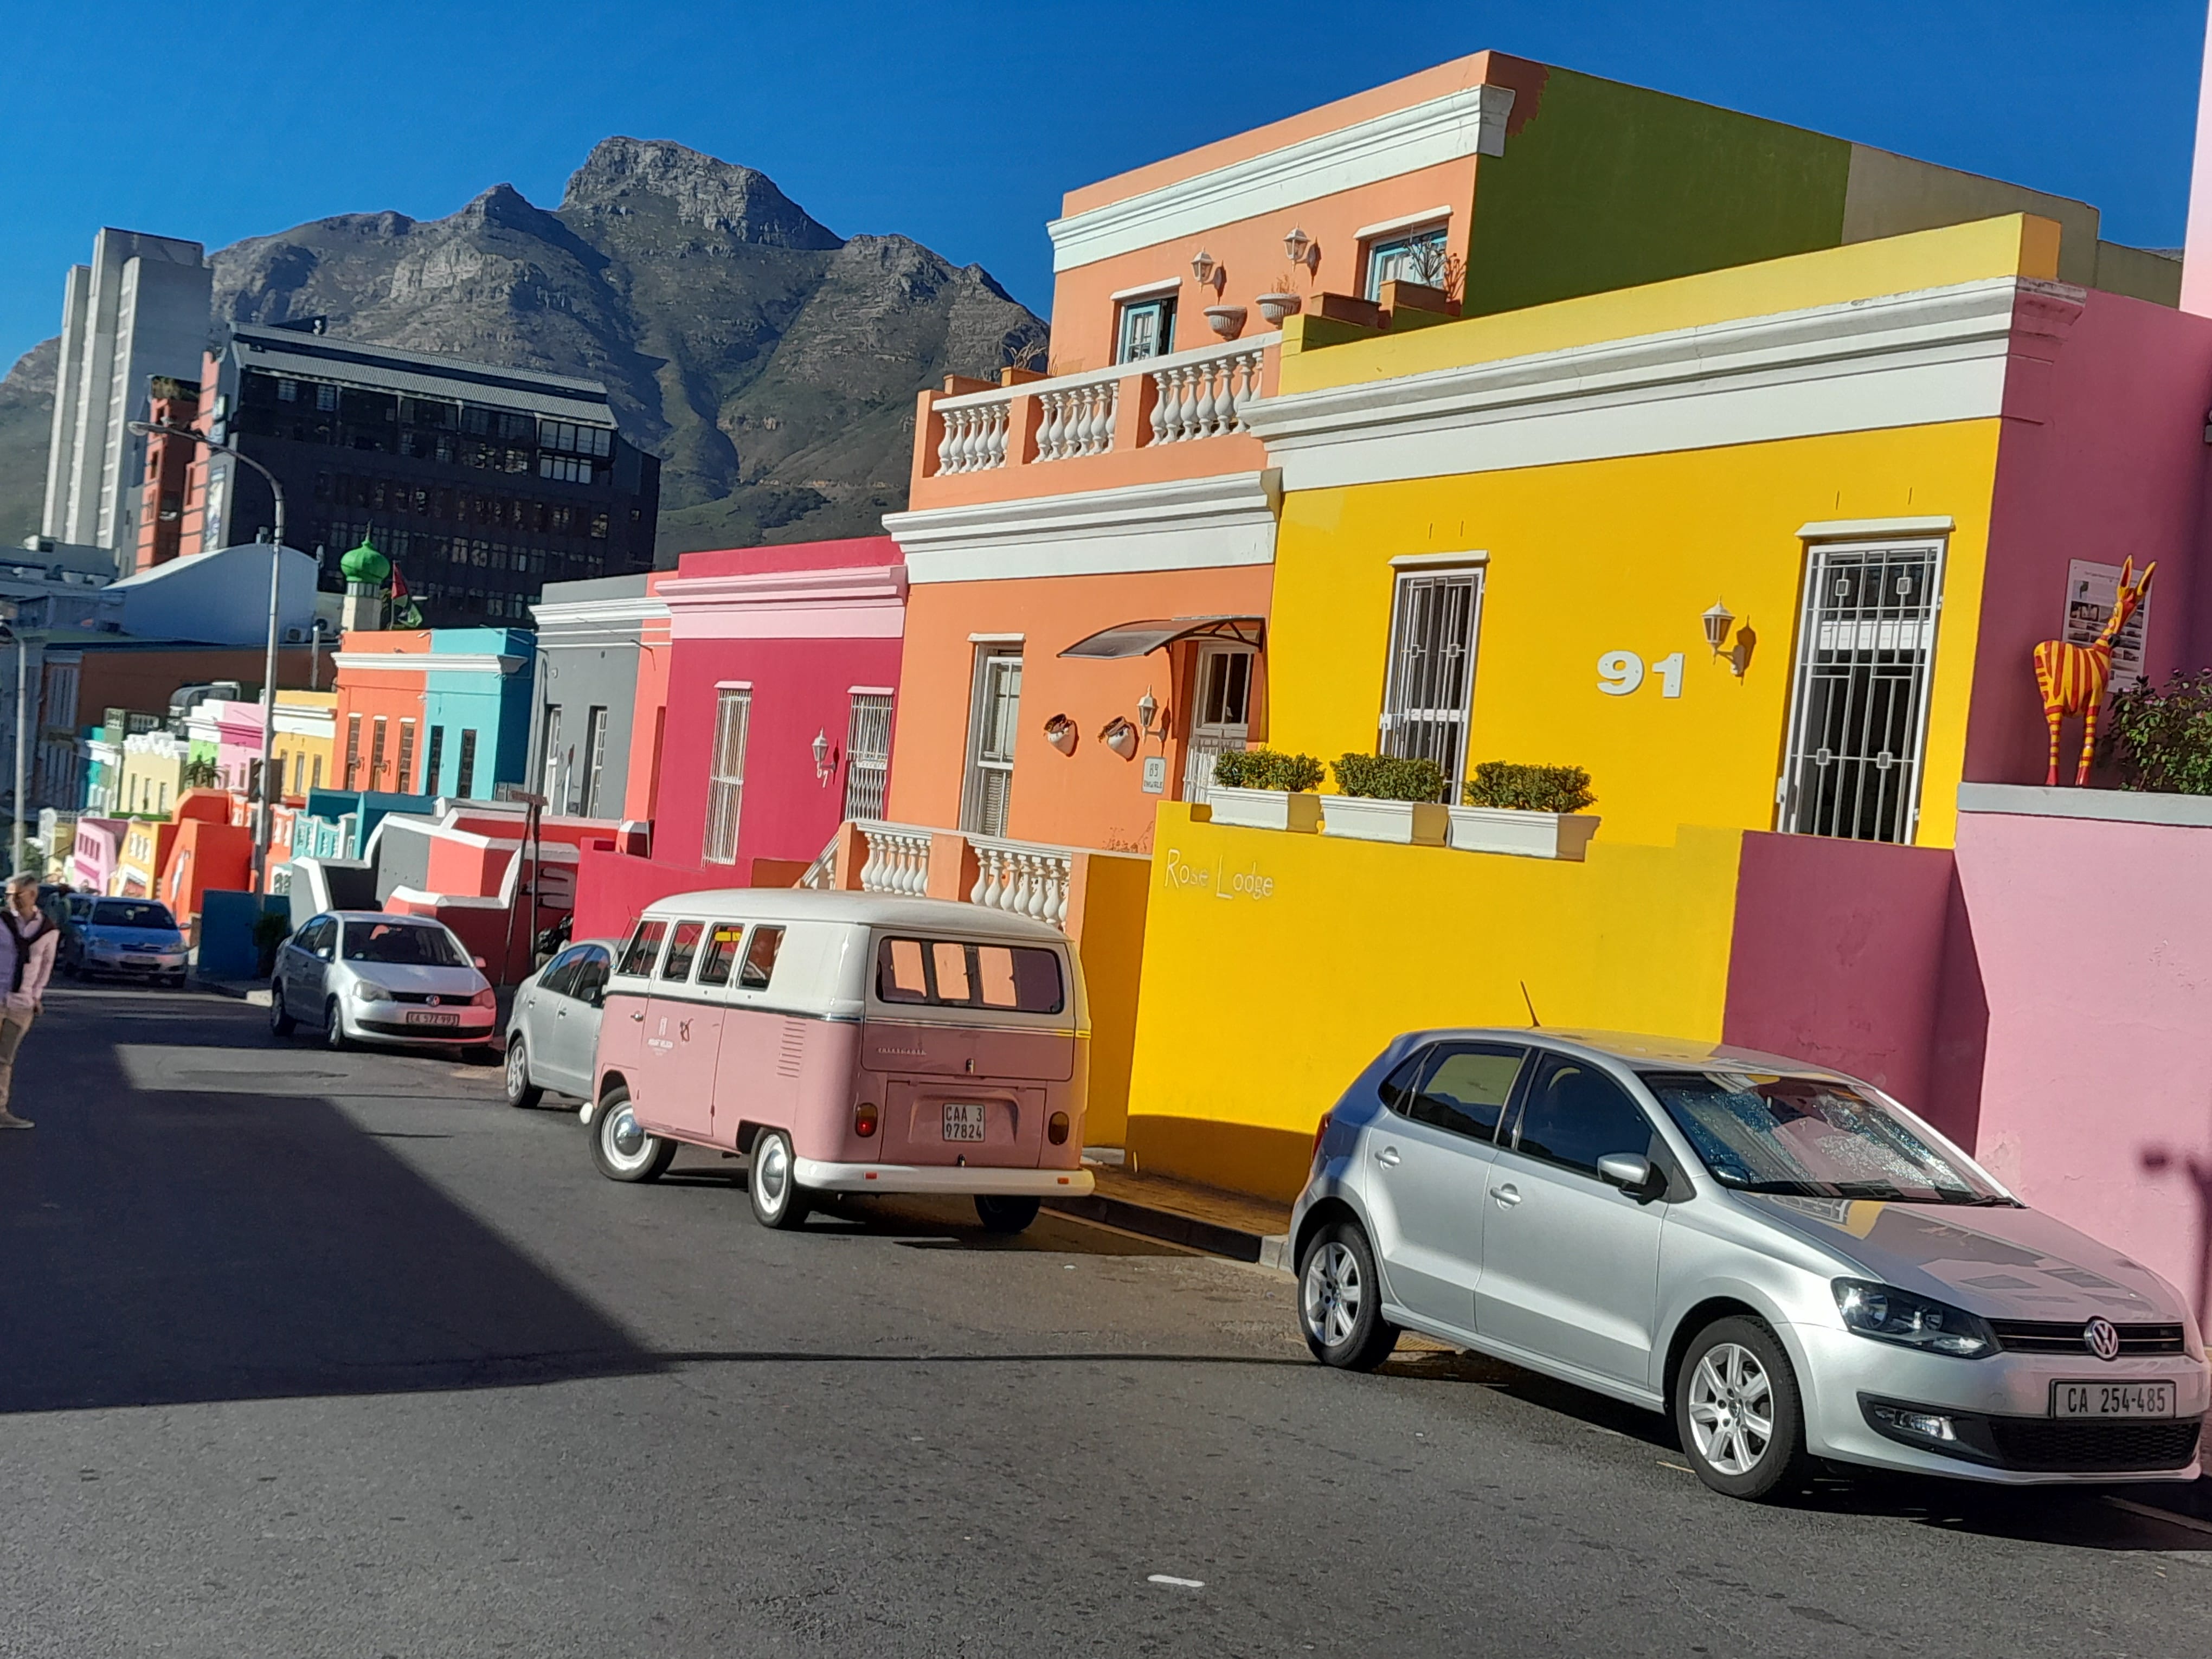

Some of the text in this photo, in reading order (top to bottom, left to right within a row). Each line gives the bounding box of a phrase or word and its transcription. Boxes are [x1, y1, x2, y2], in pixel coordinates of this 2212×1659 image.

[1597, 650, 1684, 698] 91
[1165, 848, 1274, 901] Rose Lodge
[946, 1107, 982, 1122] CAA 3
[946, 1123, 982, 1139] 97824
[2068, 1387, 2165, 1412] CA 254-485
